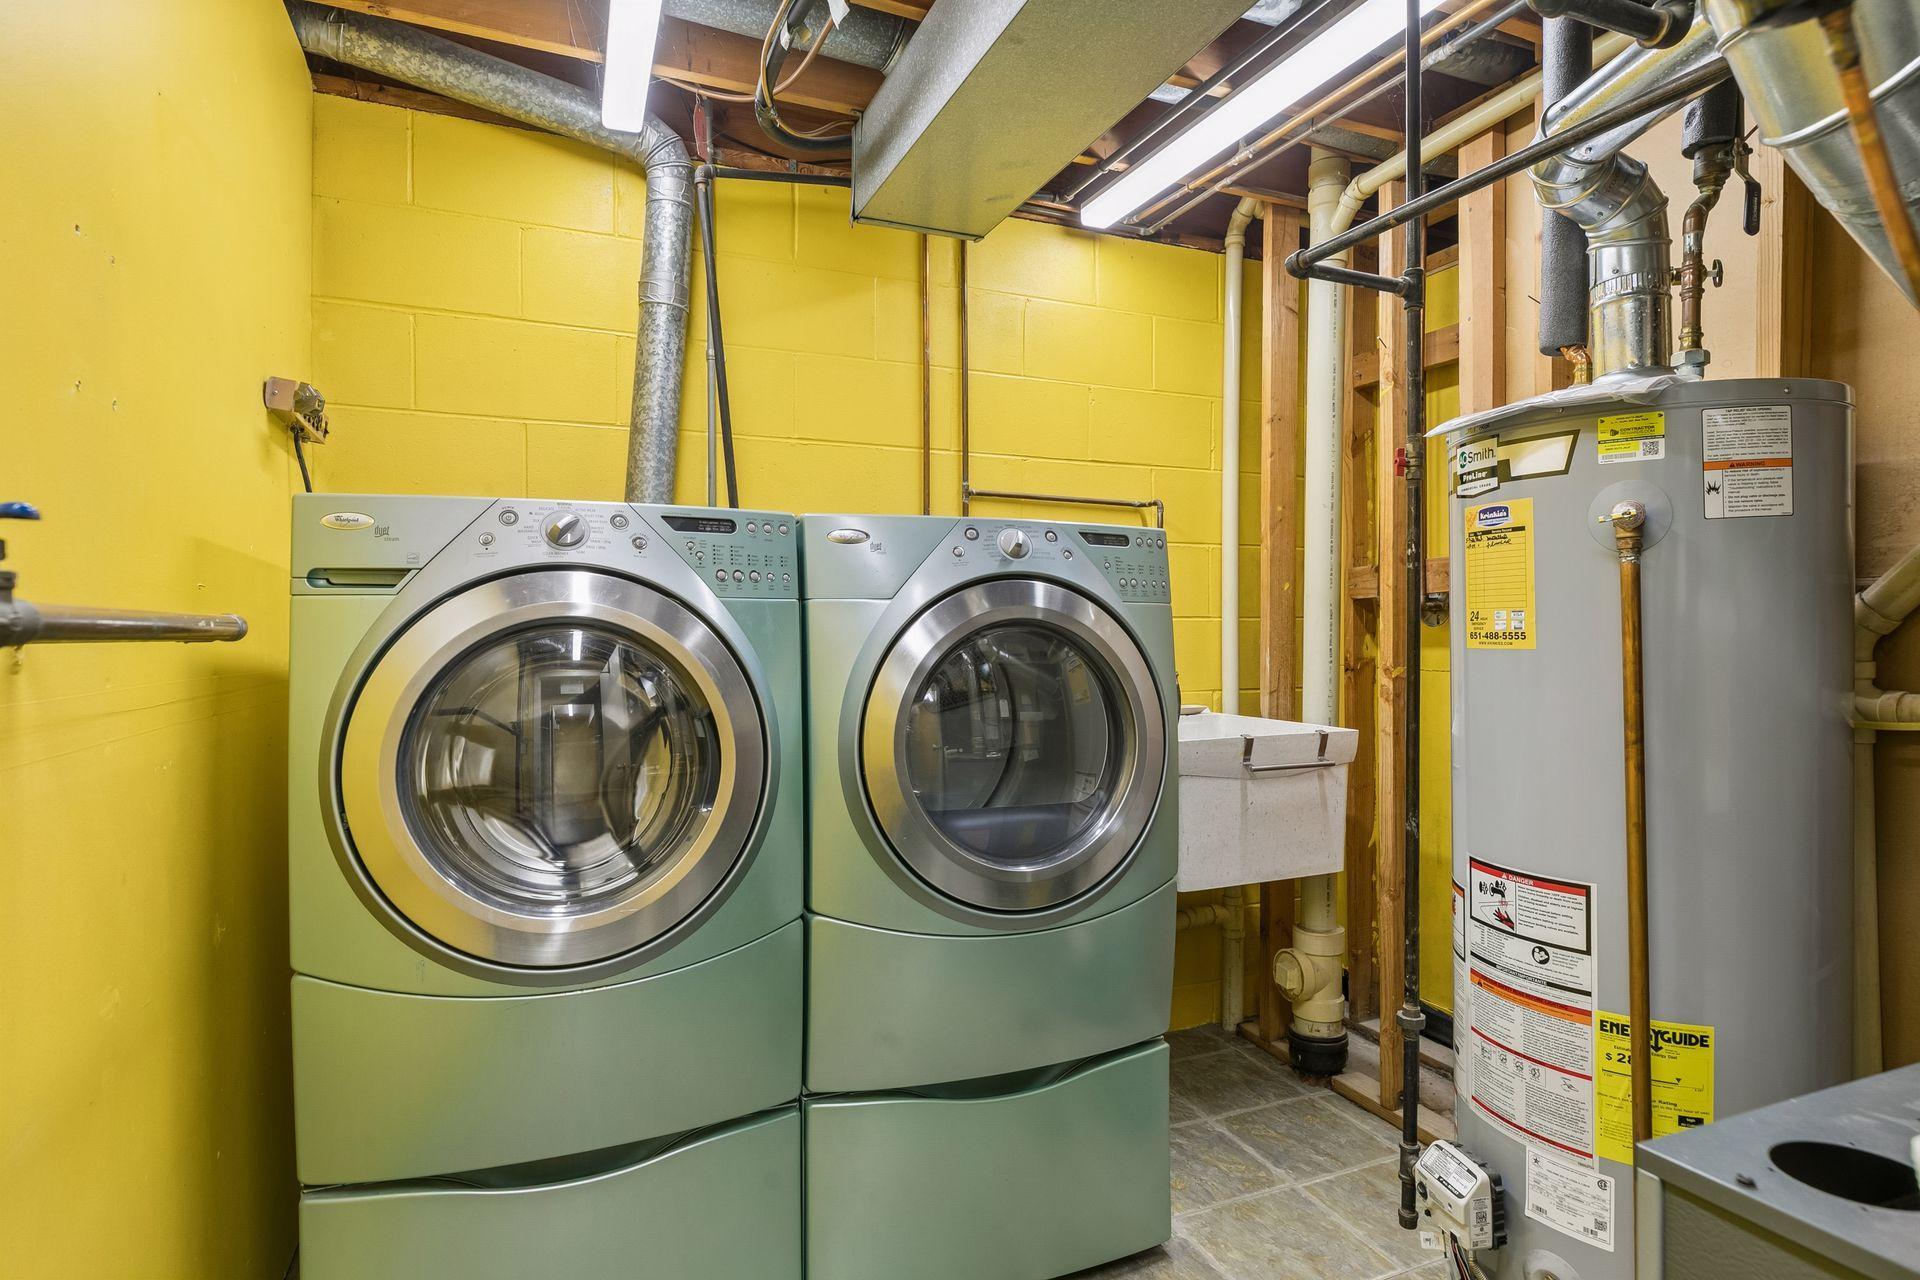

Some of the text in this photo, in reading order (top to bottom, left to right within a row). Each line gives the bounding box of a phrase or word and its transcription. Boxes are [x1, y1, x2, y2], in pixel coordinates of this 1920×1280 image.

[1467, 447, 1494, 464] Smith
[1463, 471, 1487, 482] ProLine
[334, 515, 359, 523] Whirlpool
[1470, 611, 1479, 621] 24
[1470, 632, 1526, 640] 651-488-5555
[1508, 874, 1534, 886] DANGER
[1599, 1019, 1710, 1048] ENEYGUIDE
[1605, 1052, 1613, 1061] $
[1659, 1099, 1677, 1107] Rating
